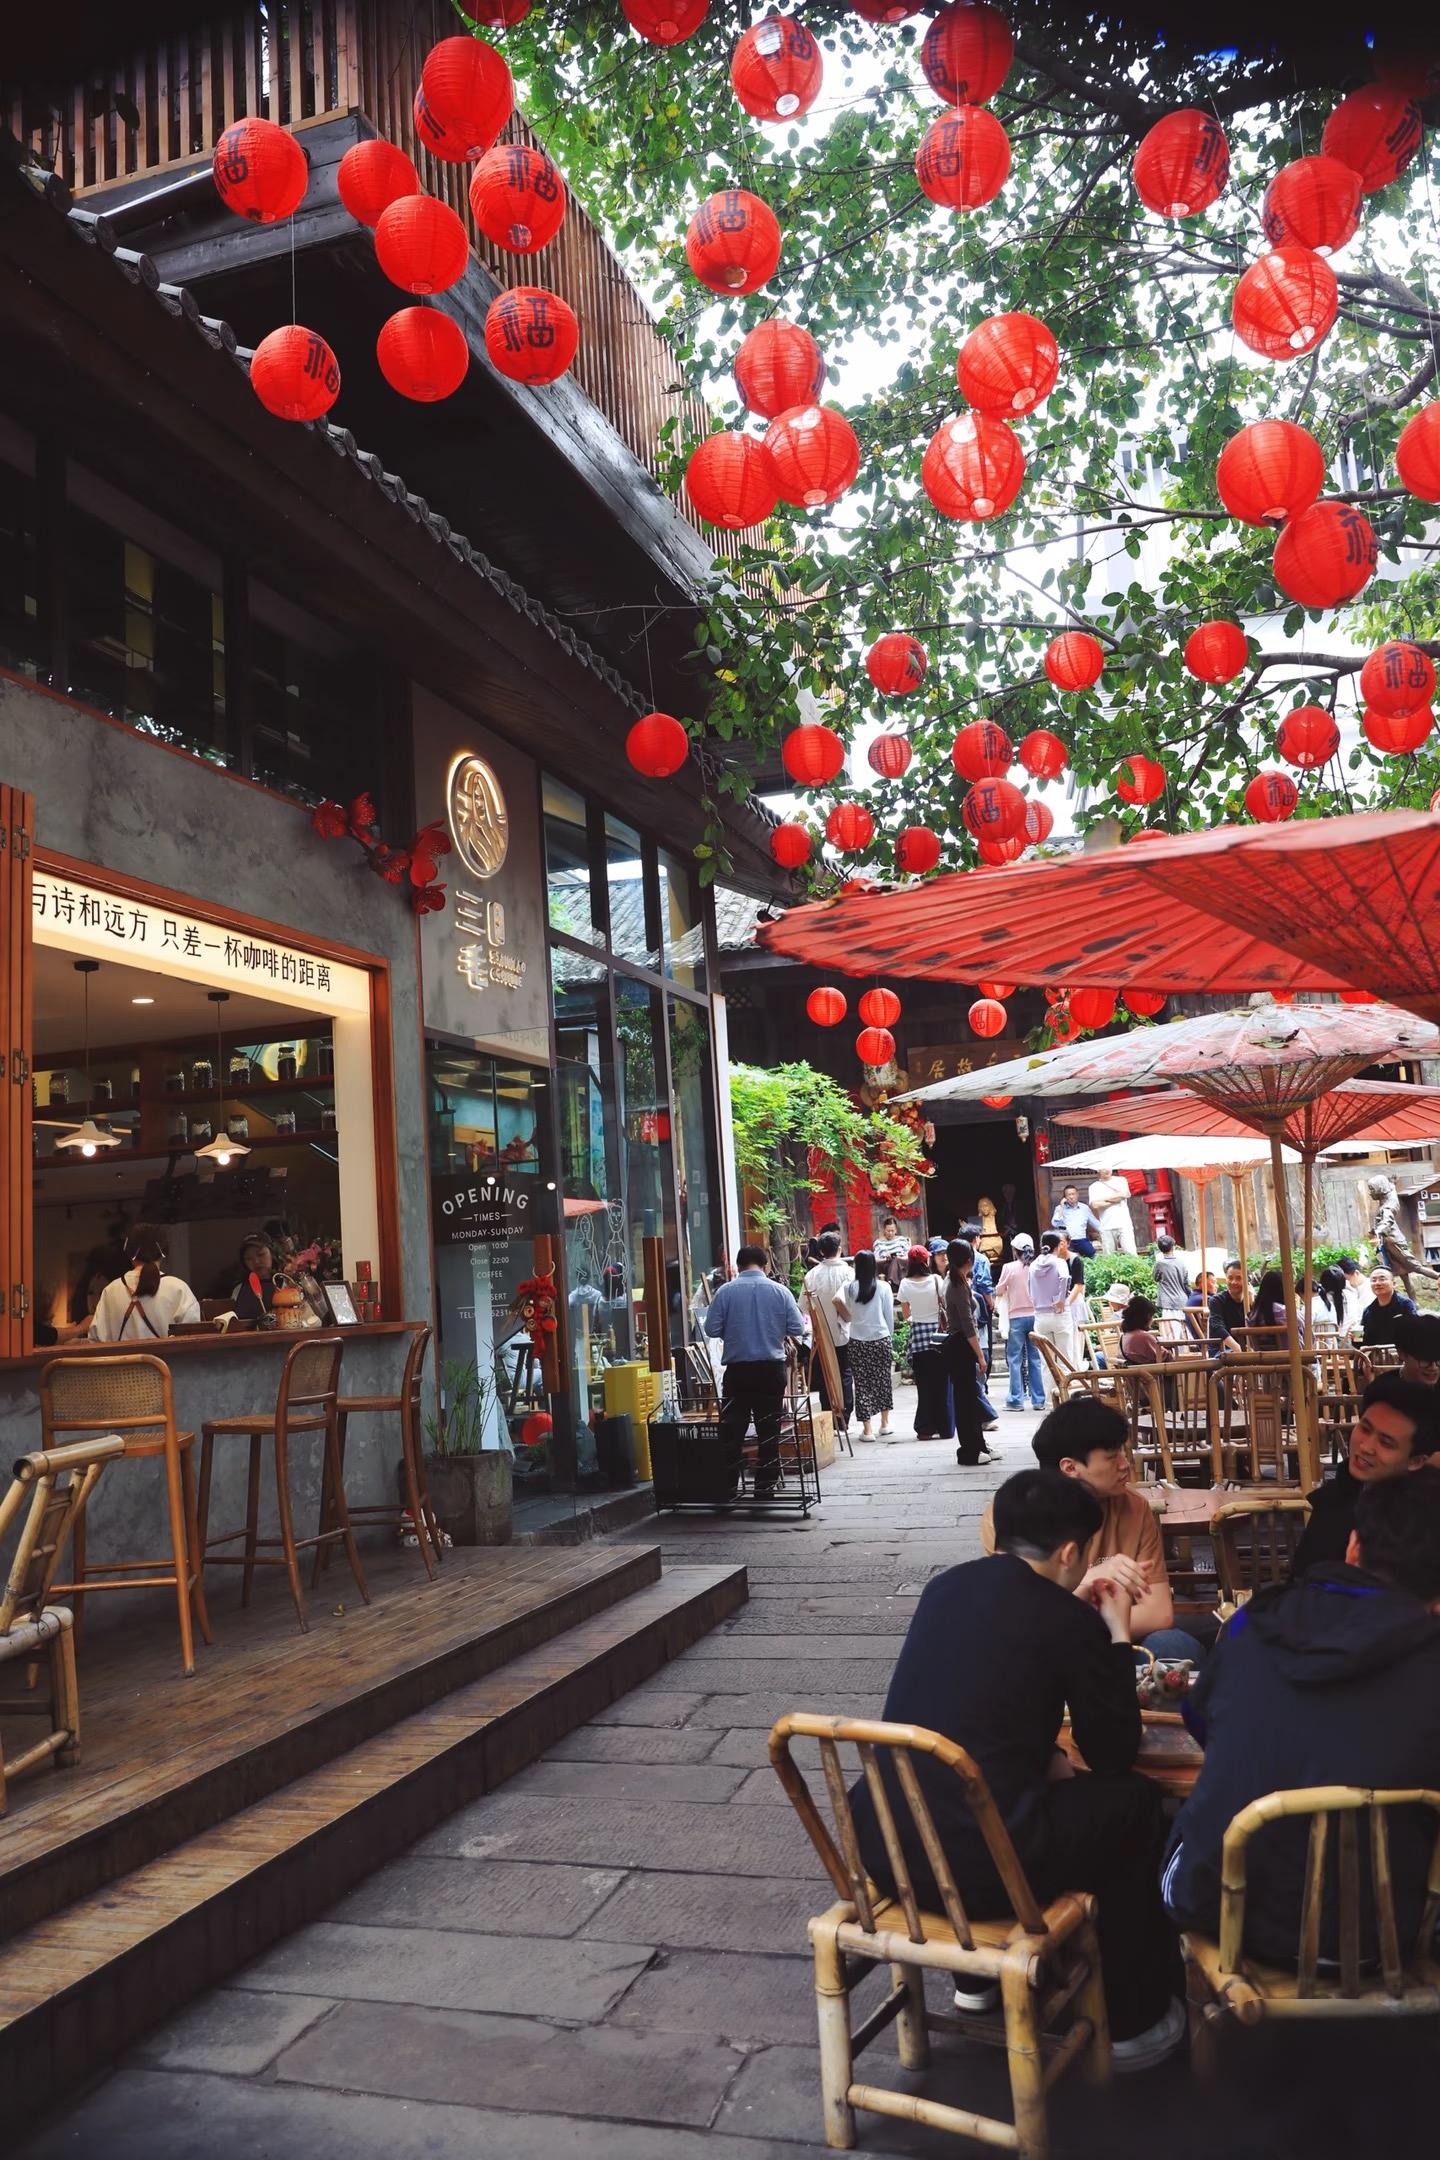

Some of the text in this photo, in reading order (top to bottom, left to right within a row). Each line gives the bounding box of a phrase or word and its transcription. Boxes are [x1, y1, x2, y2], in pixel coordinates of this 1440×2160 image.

[506, 144, 560, 204] 福
[499, 295, 556, 352] 福
[1383, 647, 1429, 689] 福
[32, 883, 332, 993] 与诗和远方 只差一杯咖啡的距离
[442, 1186, 529, 1215] OPENING
[474, 1212, 501, 1222] TIMES
[451, 1226, 524, 1239] MONDAY-SUNDAY
[468, 1242, 509, 1252] Open 10:00
[470, 1256, 510, 1266] Close 22:00
[476, 1270, 503, 1279] COFFEE
